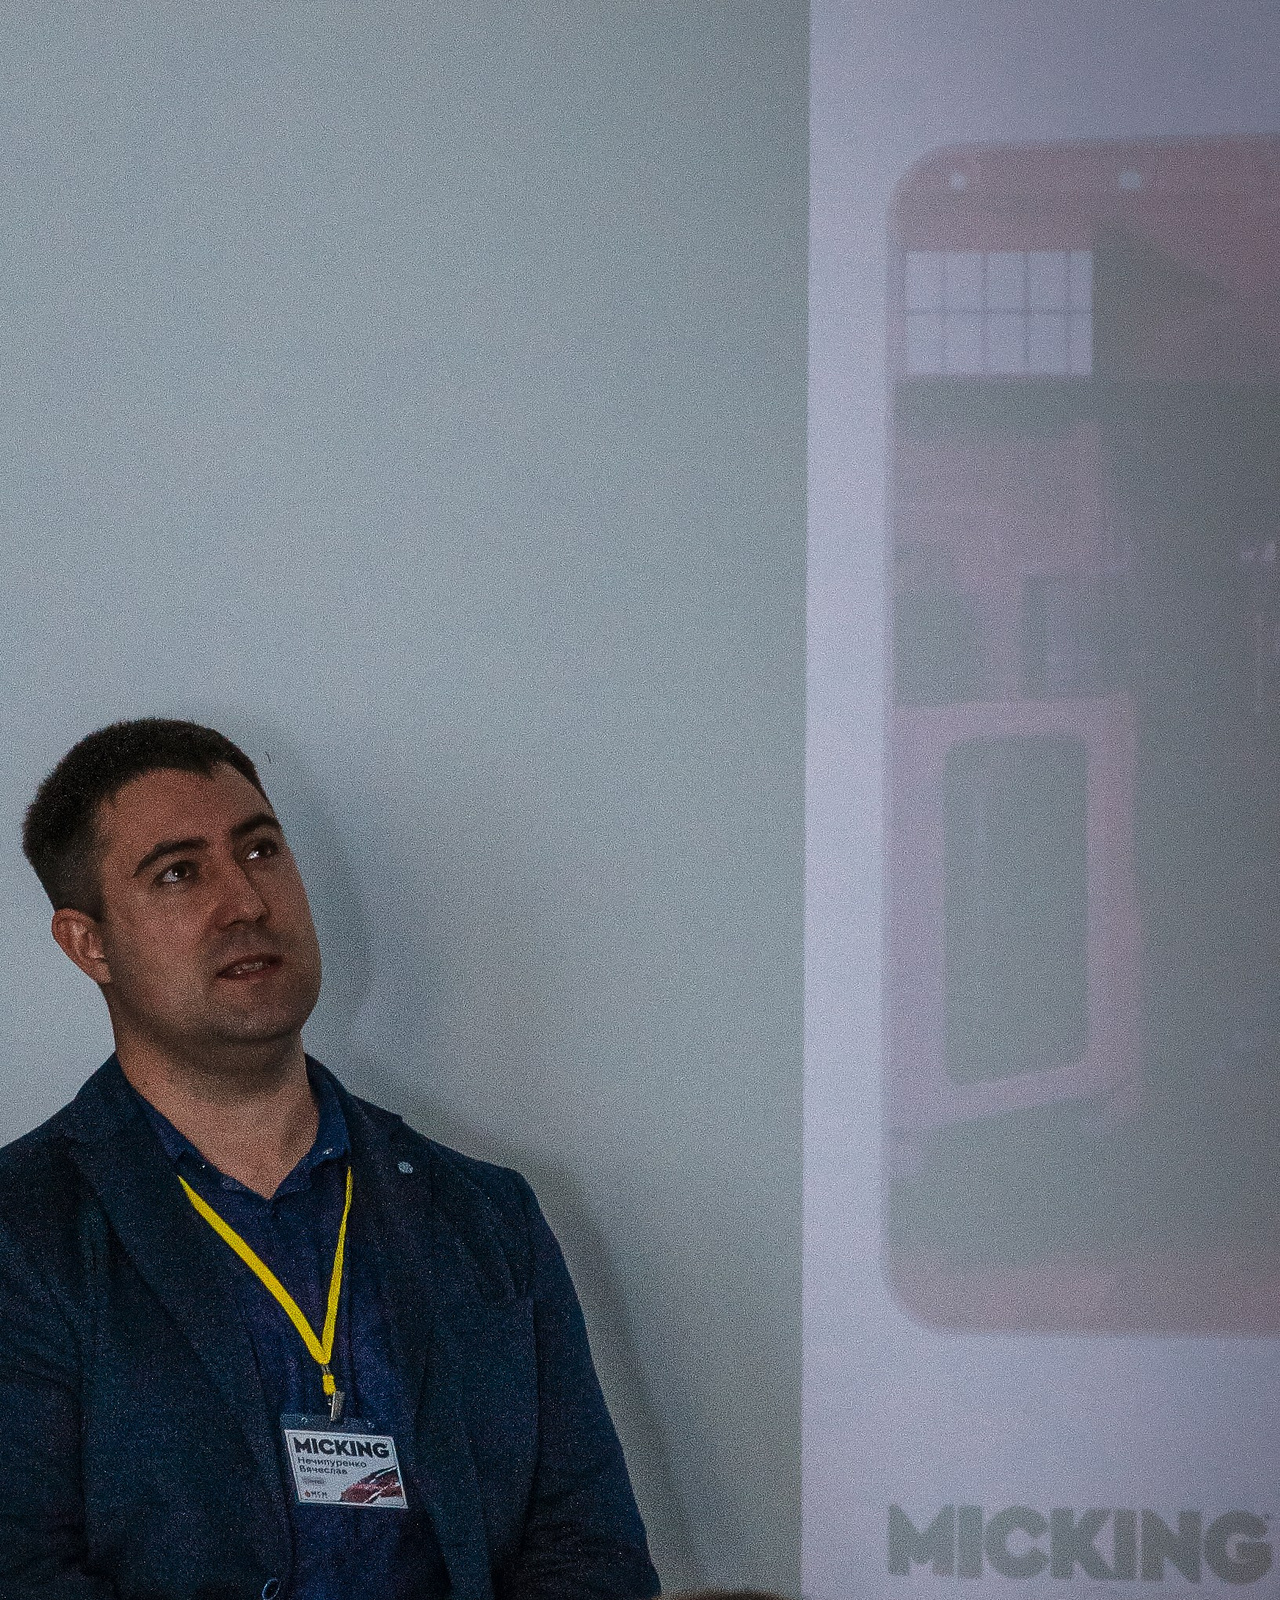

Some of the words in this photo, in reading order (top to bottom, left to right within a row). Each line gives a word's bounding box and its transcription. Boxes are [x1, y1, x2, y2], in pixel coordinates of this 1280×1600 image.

[293, 1437, 390, 1458] MICKING
[299, 1465, 348, 1475] Вячеслав
[886, 1503, 1271, 1584] MICKING
